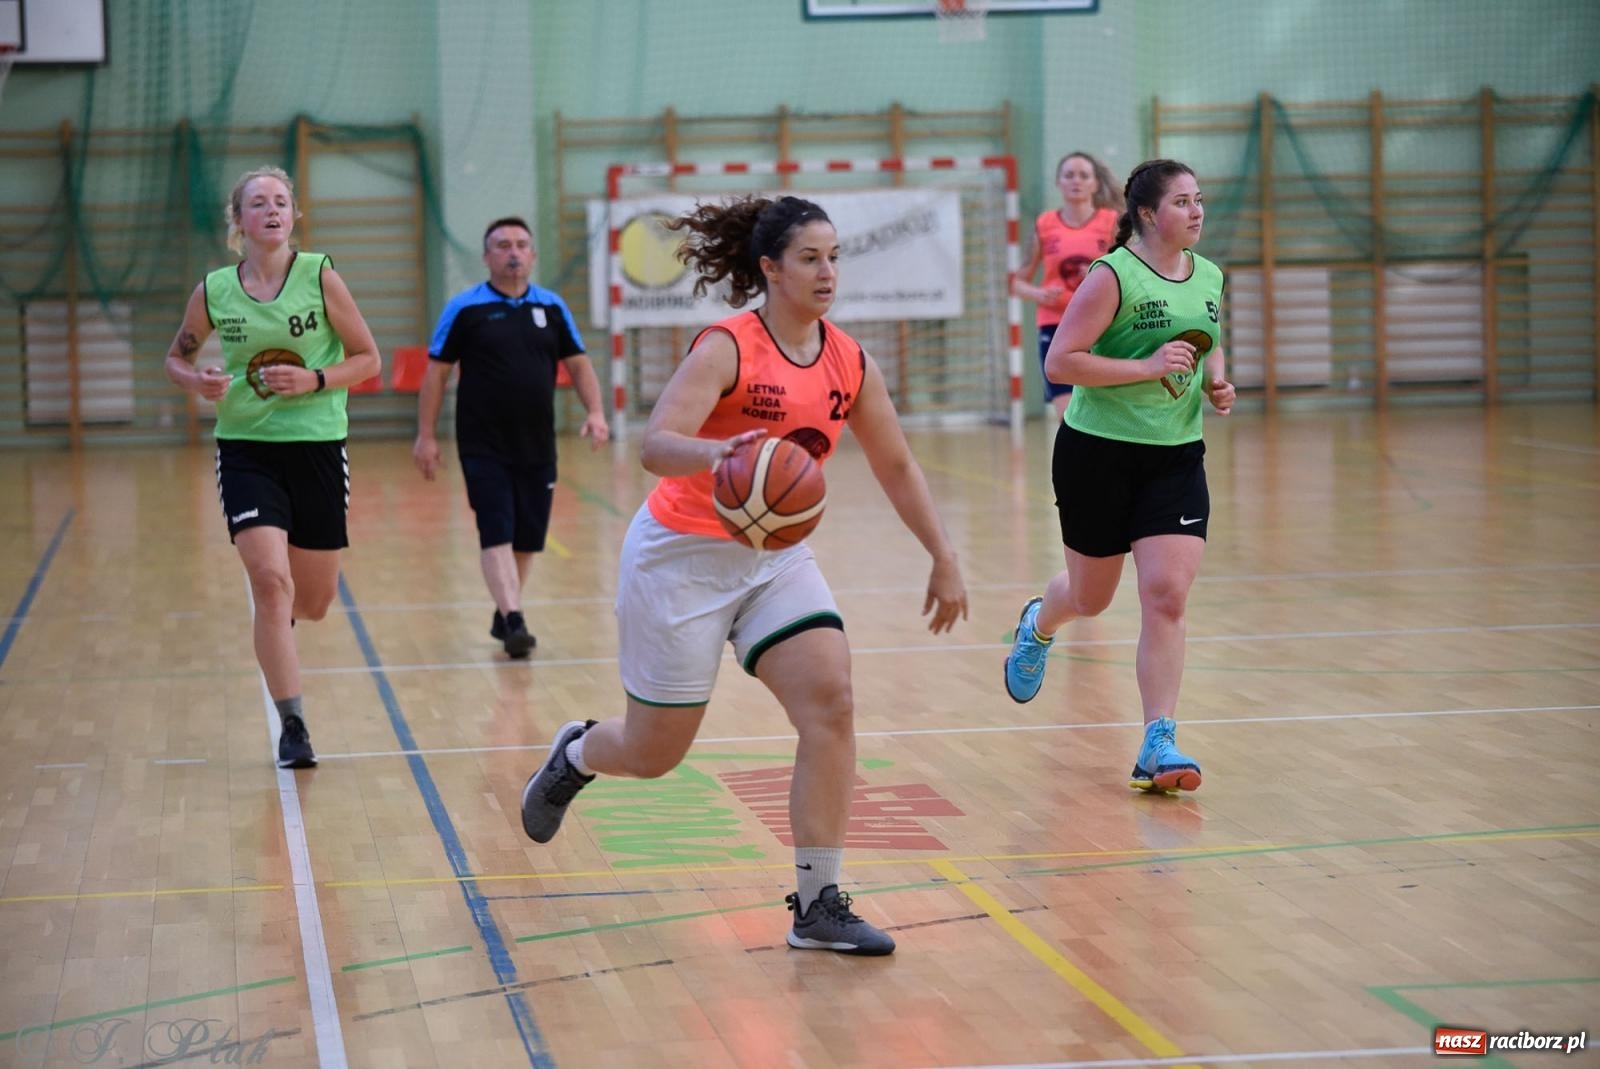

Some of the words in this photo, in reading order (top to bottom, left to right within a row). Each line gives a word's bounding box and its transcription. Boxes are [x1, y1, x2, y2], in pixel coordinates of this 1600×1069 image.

[1134, 300, 1169, 312] LETNIA
[1140, 310, 1165, 320] LIGA
[288, 311, 318, 337] 84
[1133, 319, 1172, 331] KOBIET
[747, 383, 787, 395] LETNIA
[753, 396, 781, 408] LIGA
[741, 407, 787, 422] KOBIET
